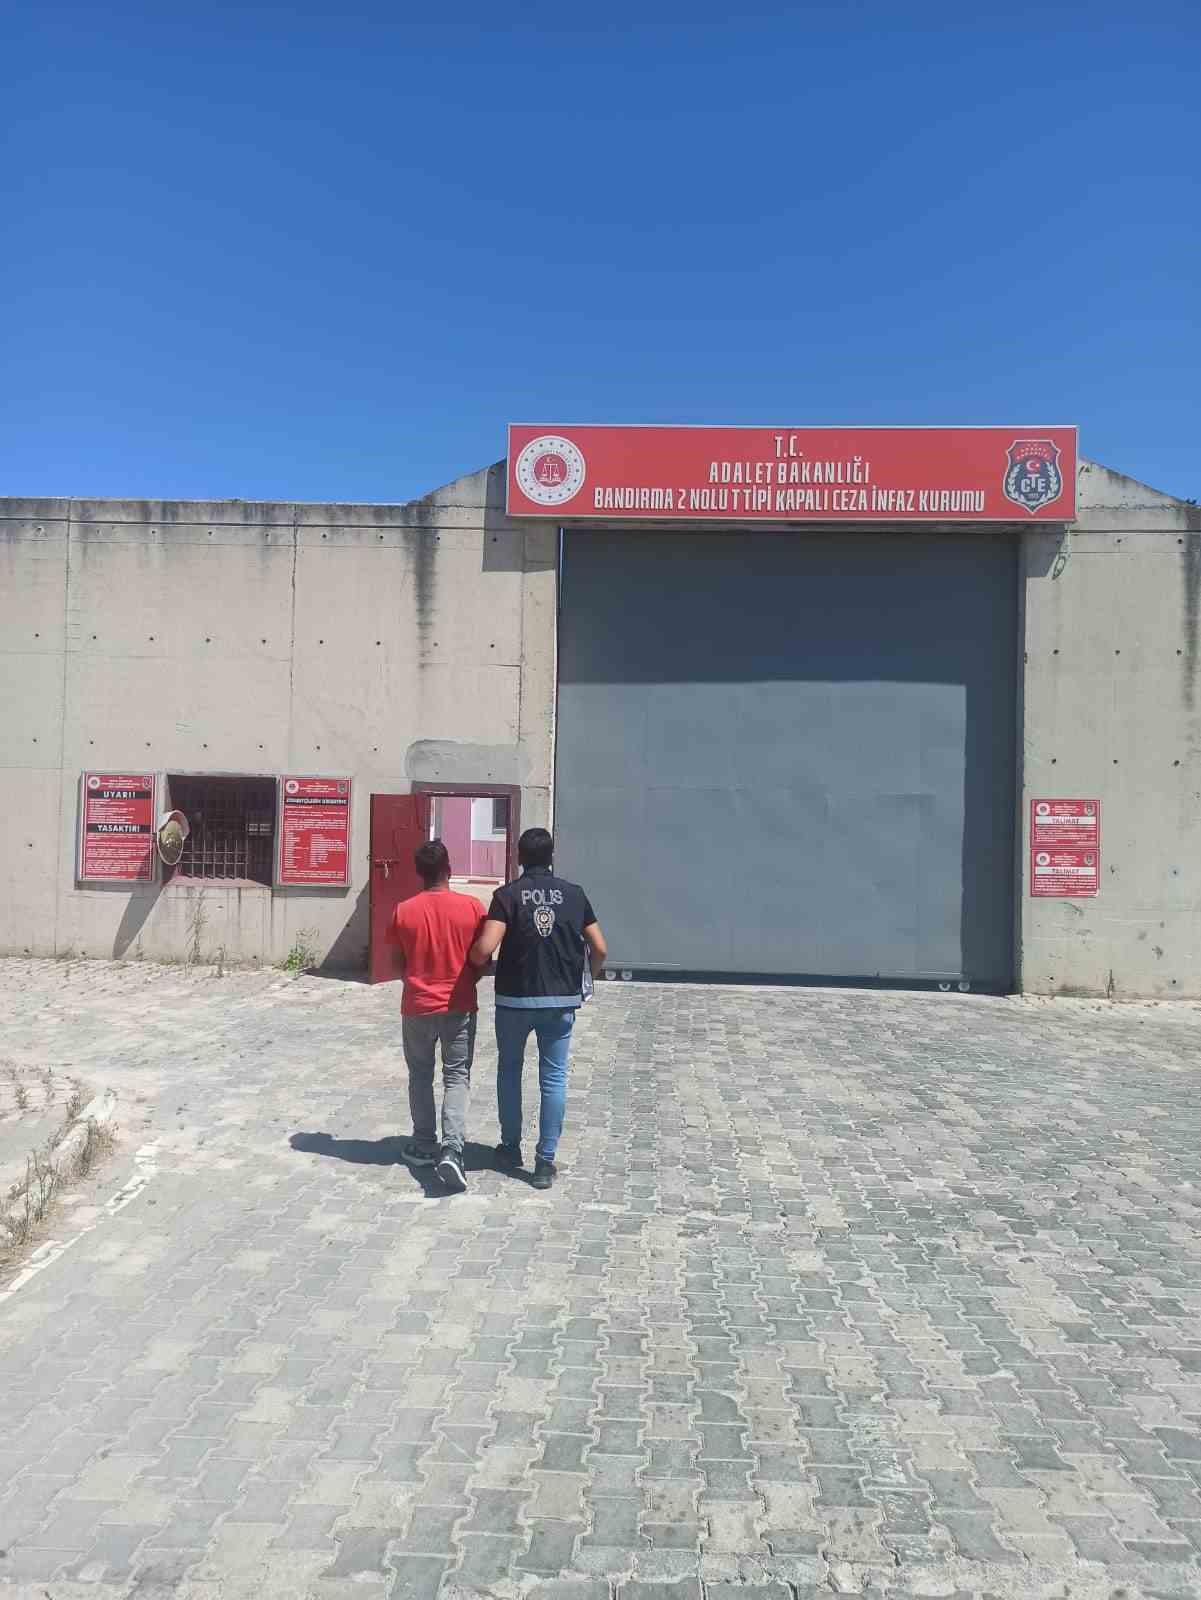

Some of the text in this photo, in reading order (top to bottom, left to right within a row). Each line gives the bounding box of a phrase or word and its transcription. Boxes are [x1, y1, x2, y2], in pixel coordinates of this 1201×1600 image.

[774, 435, 803, 458] T.C.
[709, 457, 870, 484] ADALET BAKANLIĞI
[1020, 474, 1046, 493] CTE
[594, 487, 673, 509] BANDIRMA
[678, 489, 687, 509] 2
[690, 488, 728, 509] NOLU
[743, 484, 771, 510] TİPİ
[775, 489, 828, 511] KAPALI
[832, 489, 867, 511] CEZA
[871, 485, 914, 511] İNFAZ
[918, 490, 985, 512] KURUMU
